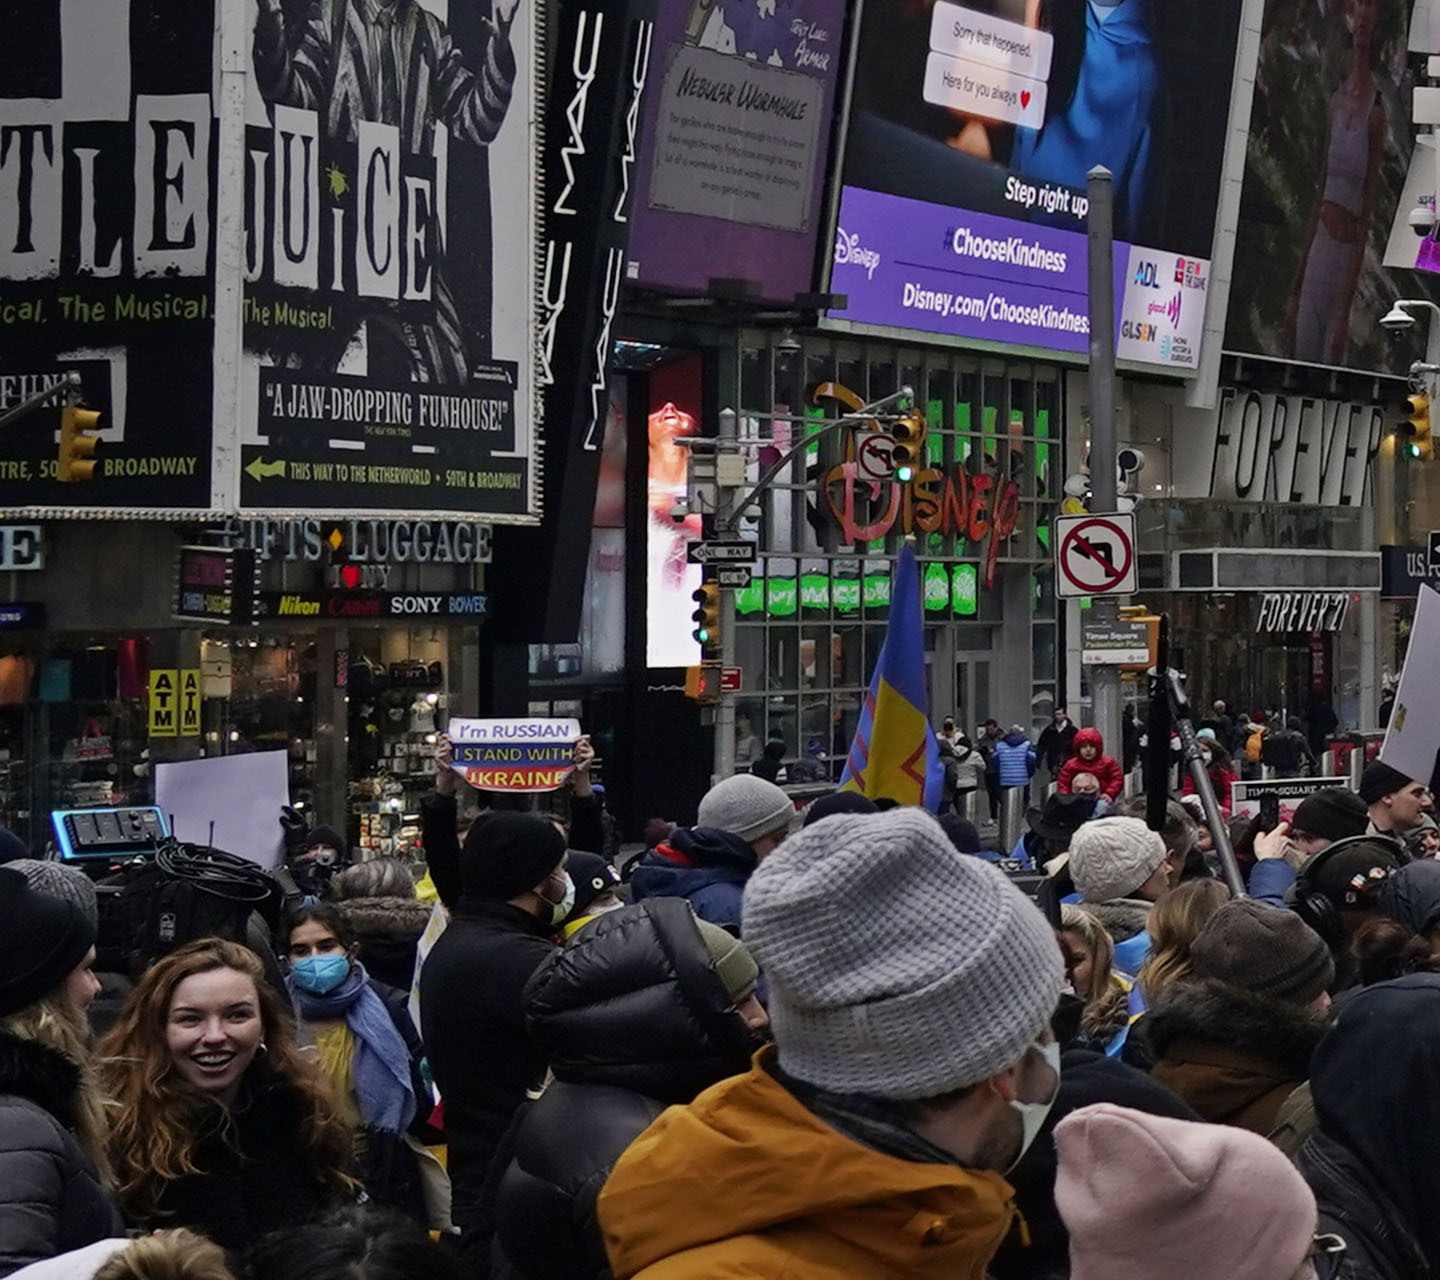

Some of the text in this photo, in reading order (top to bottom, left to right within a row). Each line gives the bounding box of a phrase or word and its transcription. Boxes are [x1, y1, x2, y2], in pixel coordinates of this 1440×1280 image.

[953, 21, 1031, 58] Sorry that happened.
[677, 68, 807, 120] NEBULAR WORMHOLE
[942, 72, 1017, 107] Here for you always
[1006, 176, 1089, 220] Step right up
[943, 225, 1067, 274] #ChooseKindness
[1134, 261, 1160, 289] ADL
[58, 294, 215, 322] The Musical.
[243, 298, 335, 329] The Musical.
[1122, 320, 1157, 342] GLSEN
[288, 385, 412, 425] JAW-DROPPING
[1210, 387, 1385, 506] FOREVER
[104, 457, 197, 475] BROADWAY
[291, 463, 521, 489] THIS WAY TO THE NETHERWORLD 50TH & BROADWAY
[226, 521, 493, 564] GIFTS LUGGAGE
[699, 547, 749, 558] ONE WAY
[279, 597, 320, 615] Nikon
[391, 597, 442, 614] SONY
[449, 597, 486, 613] BOWER
[1256, 593, 1328, 632] FOREVER
[1085, 632, 1138, 641] Times Square
[155, 673, 172, 726] ATM
[185, 673, 197, 726] ATM
[492, 724, 569, 738] RUSSIAN
[455, 748, 572, 761] I STAND WITH
